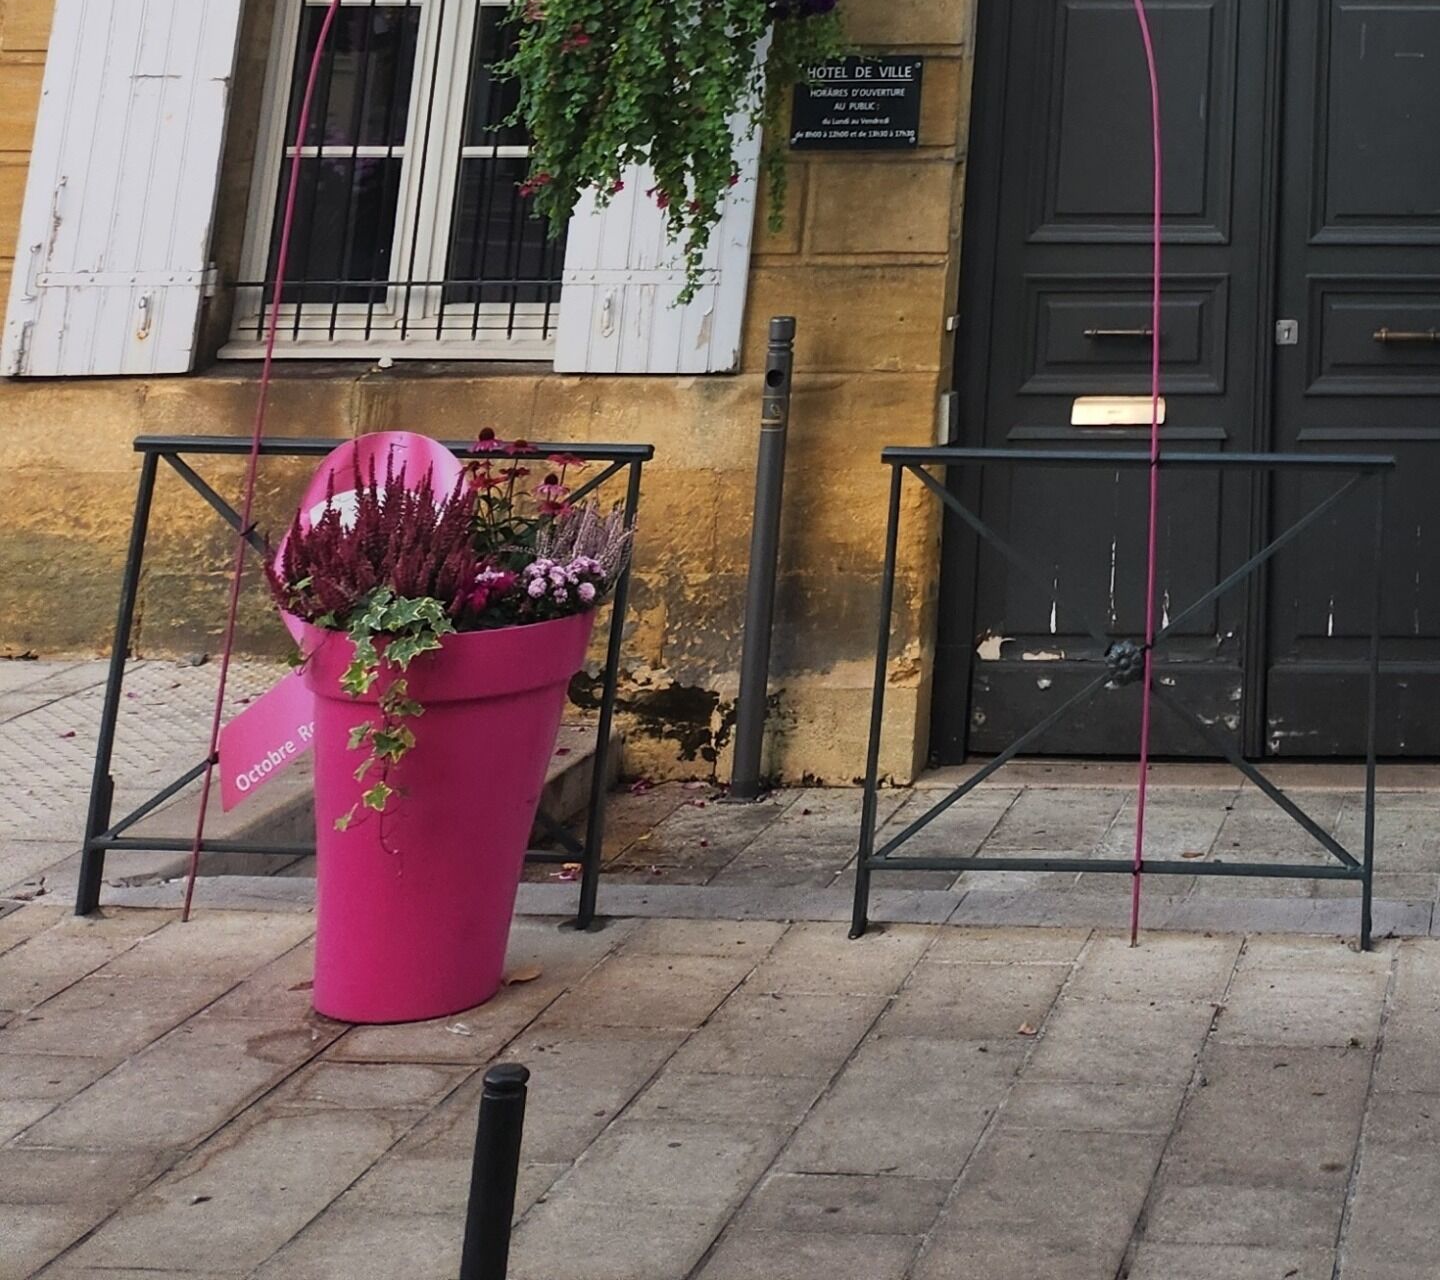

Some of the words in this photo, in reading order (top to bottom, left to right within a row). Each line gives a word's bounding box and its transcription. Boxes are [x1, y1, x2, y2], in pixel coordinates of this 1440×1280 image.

[855, 66, 872, 78] DE
[879, 65, 912, 78] VILLE
[851, 87, 906, 97] D'OUVERTURE
[833, 102, 846, 111] AU
[860, 117, 890, 125] Vendredi
[235, 740, 297, 792] Octobre
